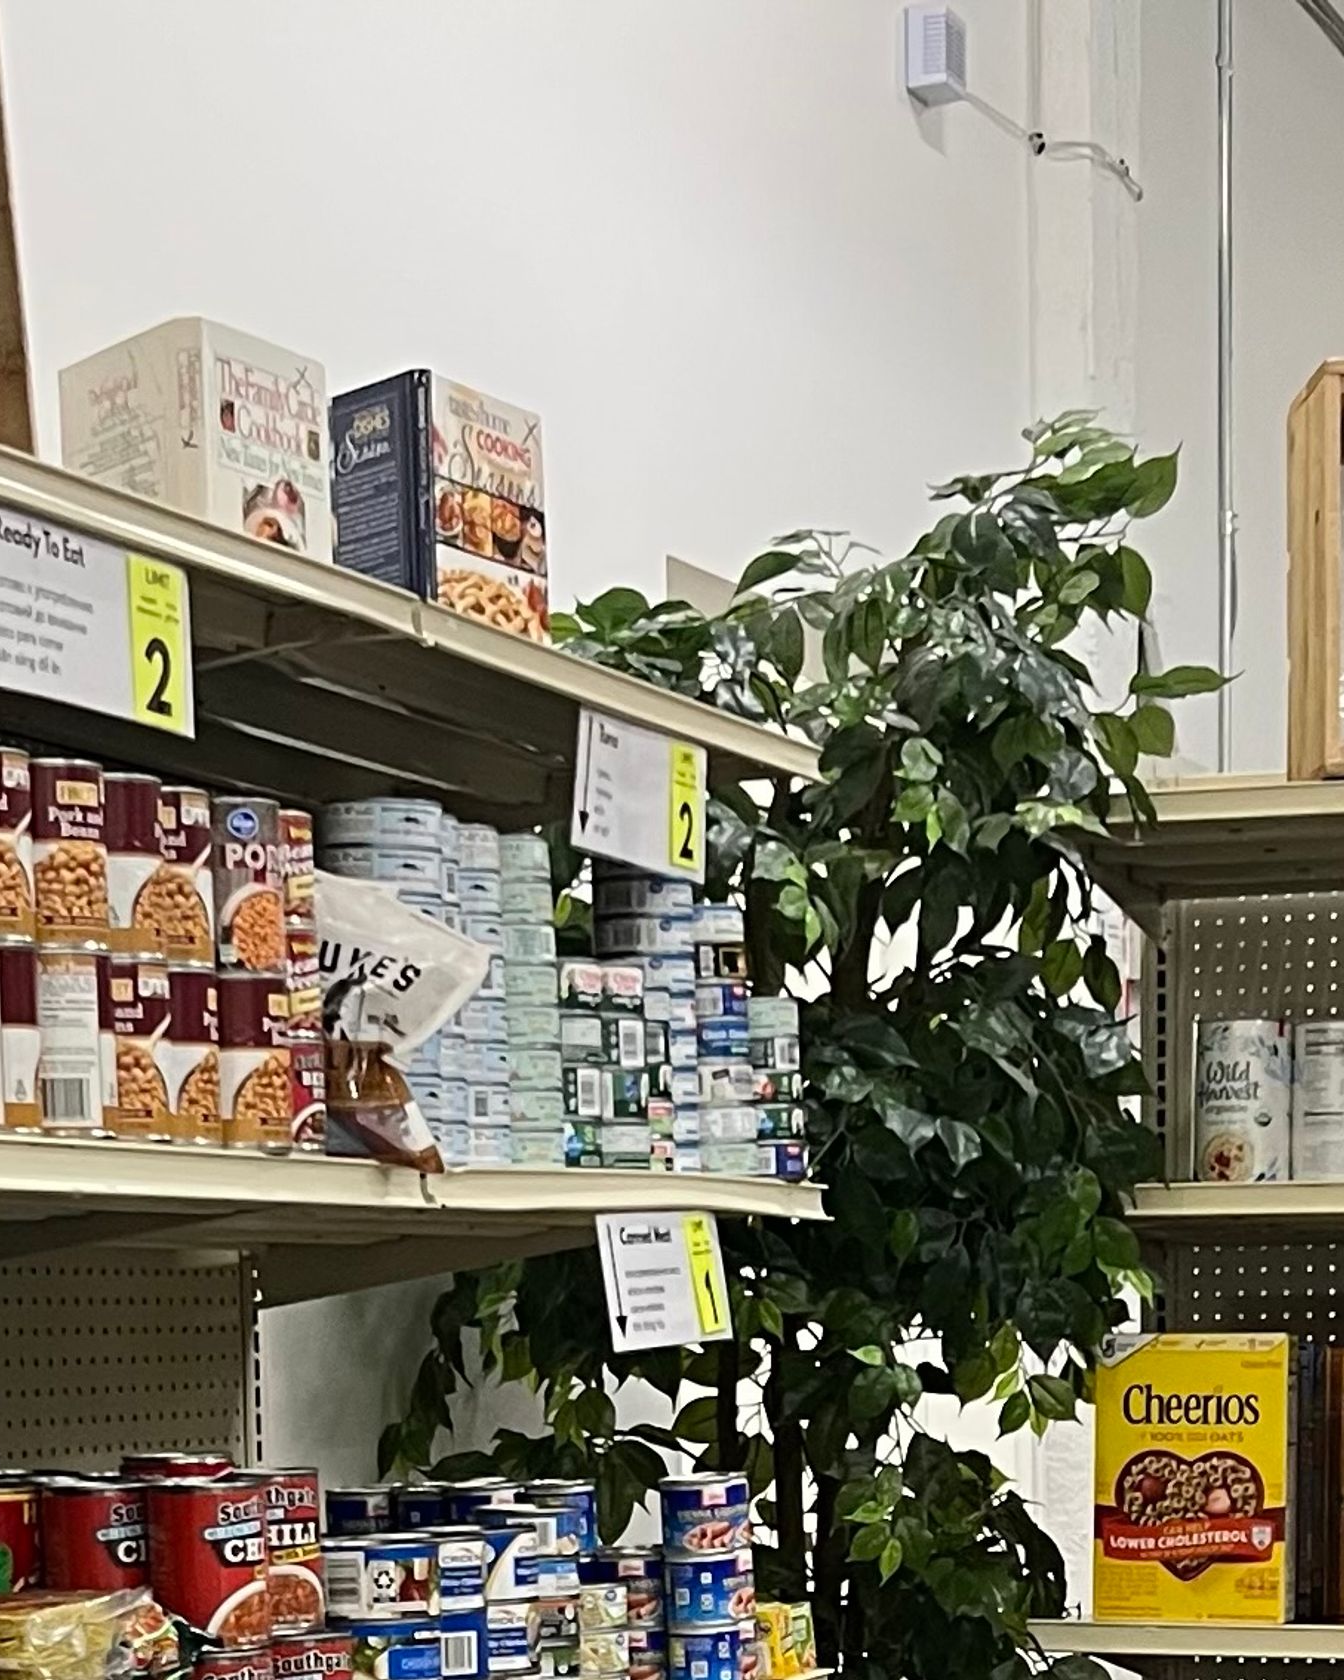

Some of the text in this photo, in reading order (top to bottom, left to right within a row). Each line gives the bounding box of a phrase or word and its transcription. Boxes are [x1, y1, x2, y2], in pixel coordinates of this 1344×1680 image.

[42, 530, 60, 558] To
[63, 537, 86, 568] Eat
[145, 637, 173, 717] 2
[679, 802, 693, 861] 2
[318, 940, 422, 993] UKE'S
[1206, 1061, 1251, 1085] Wild
[704, 1269, 719, 1324] 1
[1122, 1383, 1260, 1427] Cheerios
[1109, 1529, 1249, 1551] LOWER CHOLESTEROL
